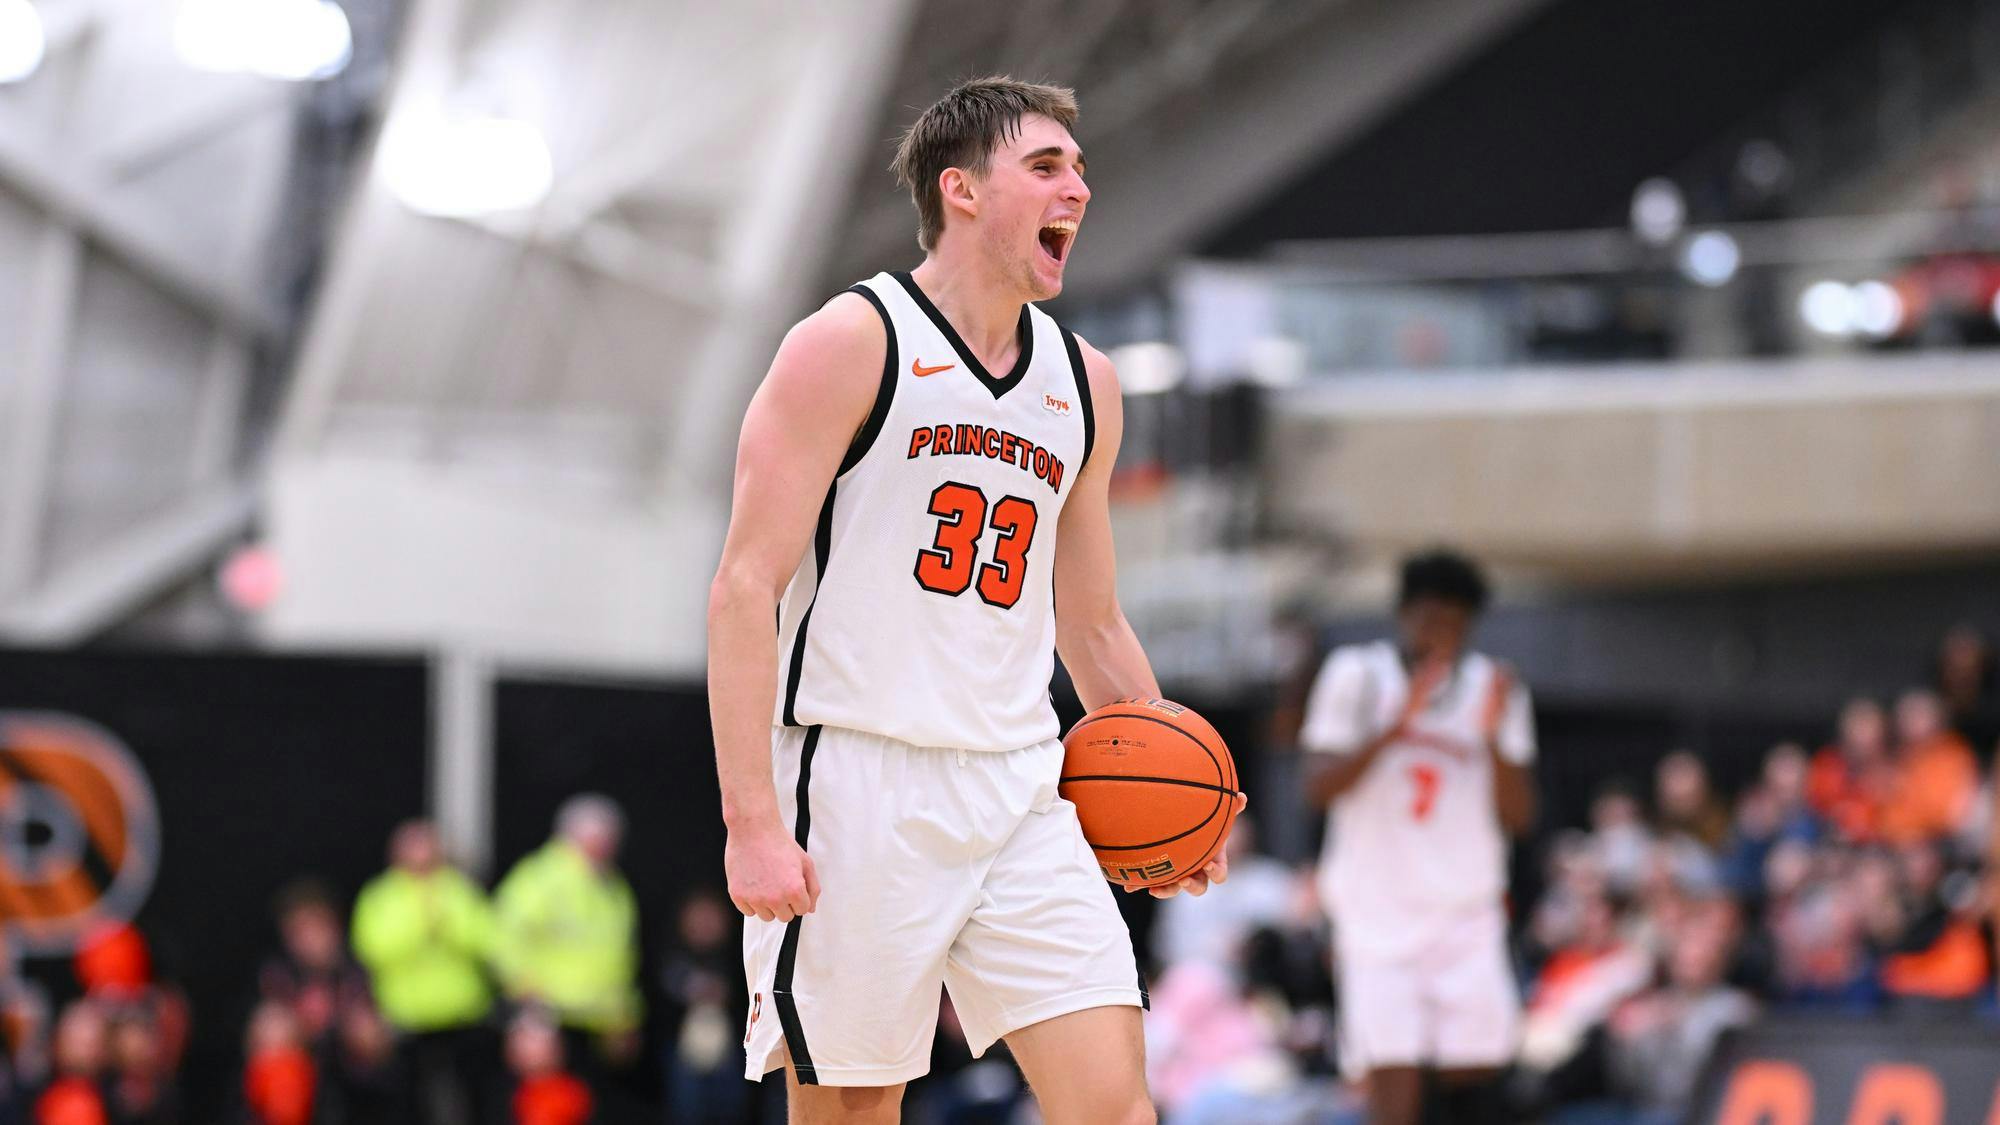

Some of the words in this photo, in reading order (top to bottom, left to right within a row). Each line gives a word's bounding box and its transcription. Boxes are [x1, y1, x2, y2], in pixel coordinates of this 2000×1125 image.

[1045, 394, 1061, 410] Ivy
[907, 424, 1064, 494] PRINCETON
[913, 480, 1038, 610] 33
